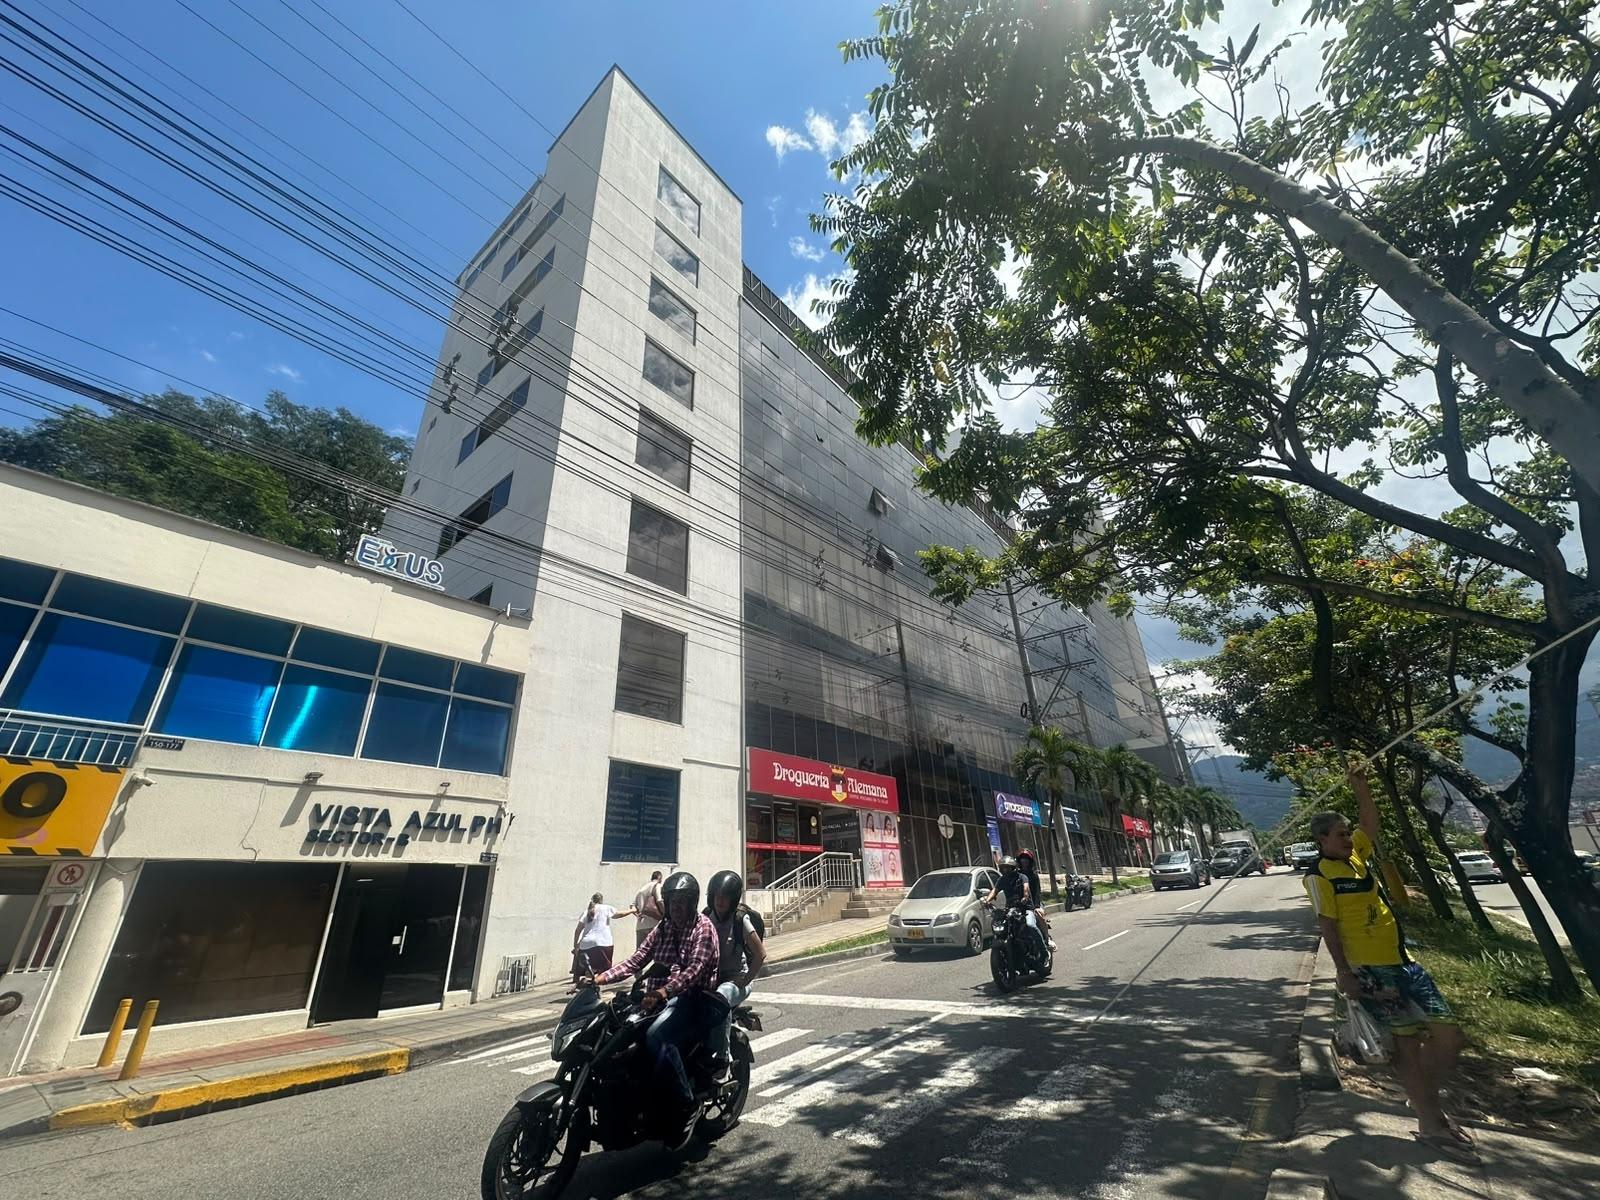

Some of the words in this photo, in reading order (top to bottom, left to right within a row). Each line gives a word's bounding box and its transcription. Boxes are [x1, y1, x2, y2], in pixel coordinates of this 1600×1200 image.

[772, 762, 830, 788] Droguería
[847, 777, 889, 799] Alemana
[313, 803, 392, 827] VISTA
[403, 810, 467, 832] AZUL
[469, 815, 501, 834] PH
